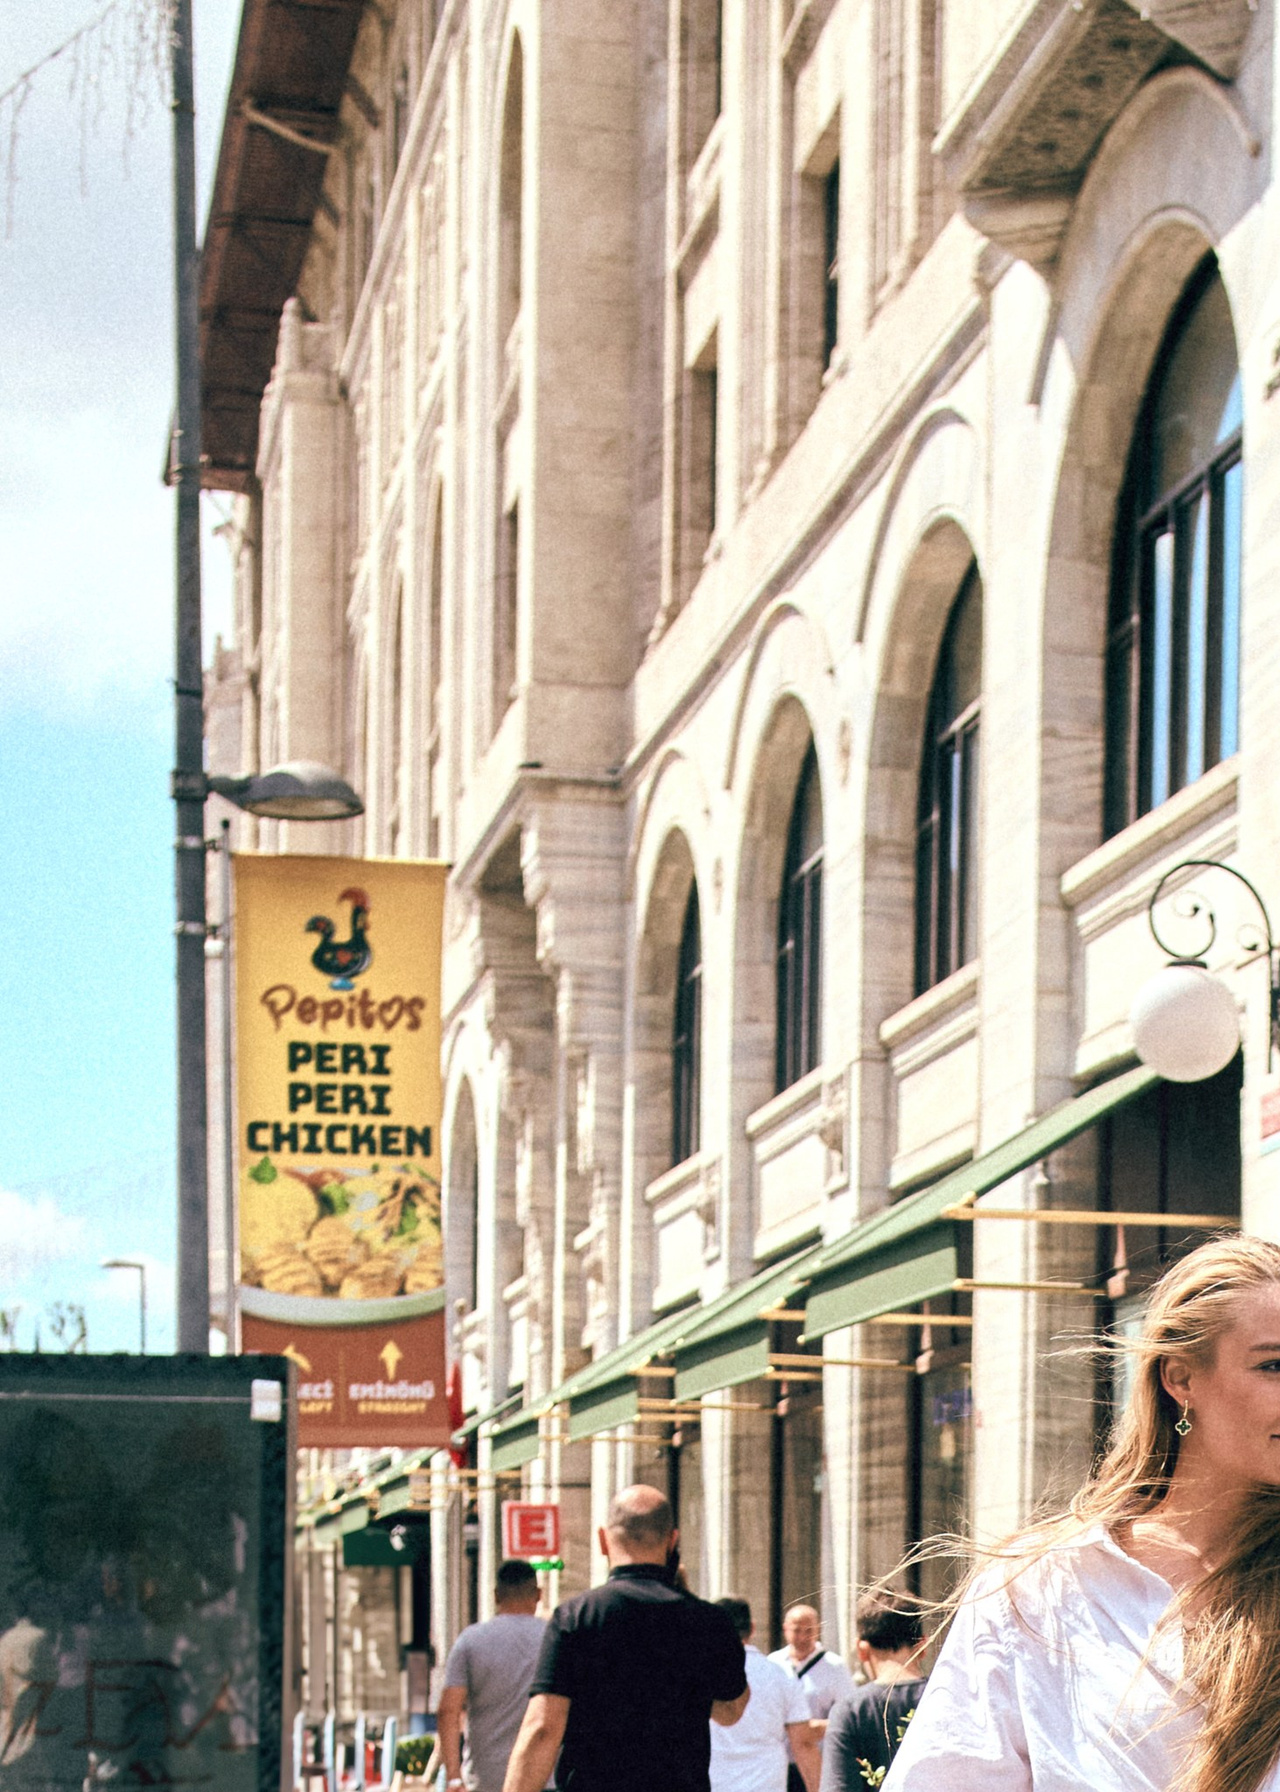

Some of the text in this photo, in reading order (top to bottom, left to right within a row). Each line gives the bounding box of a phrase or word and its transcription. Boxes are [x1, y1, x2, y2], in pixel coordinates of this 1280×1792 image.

[260, 984, 427, 1032] Pepitos
[288, 1041, 391, 1075] PERI
[288, 1082, 392, 1116] PERI
[247, 1121, 432, 1157] CHICKEN
[519, 1512, 547, 1547] E
